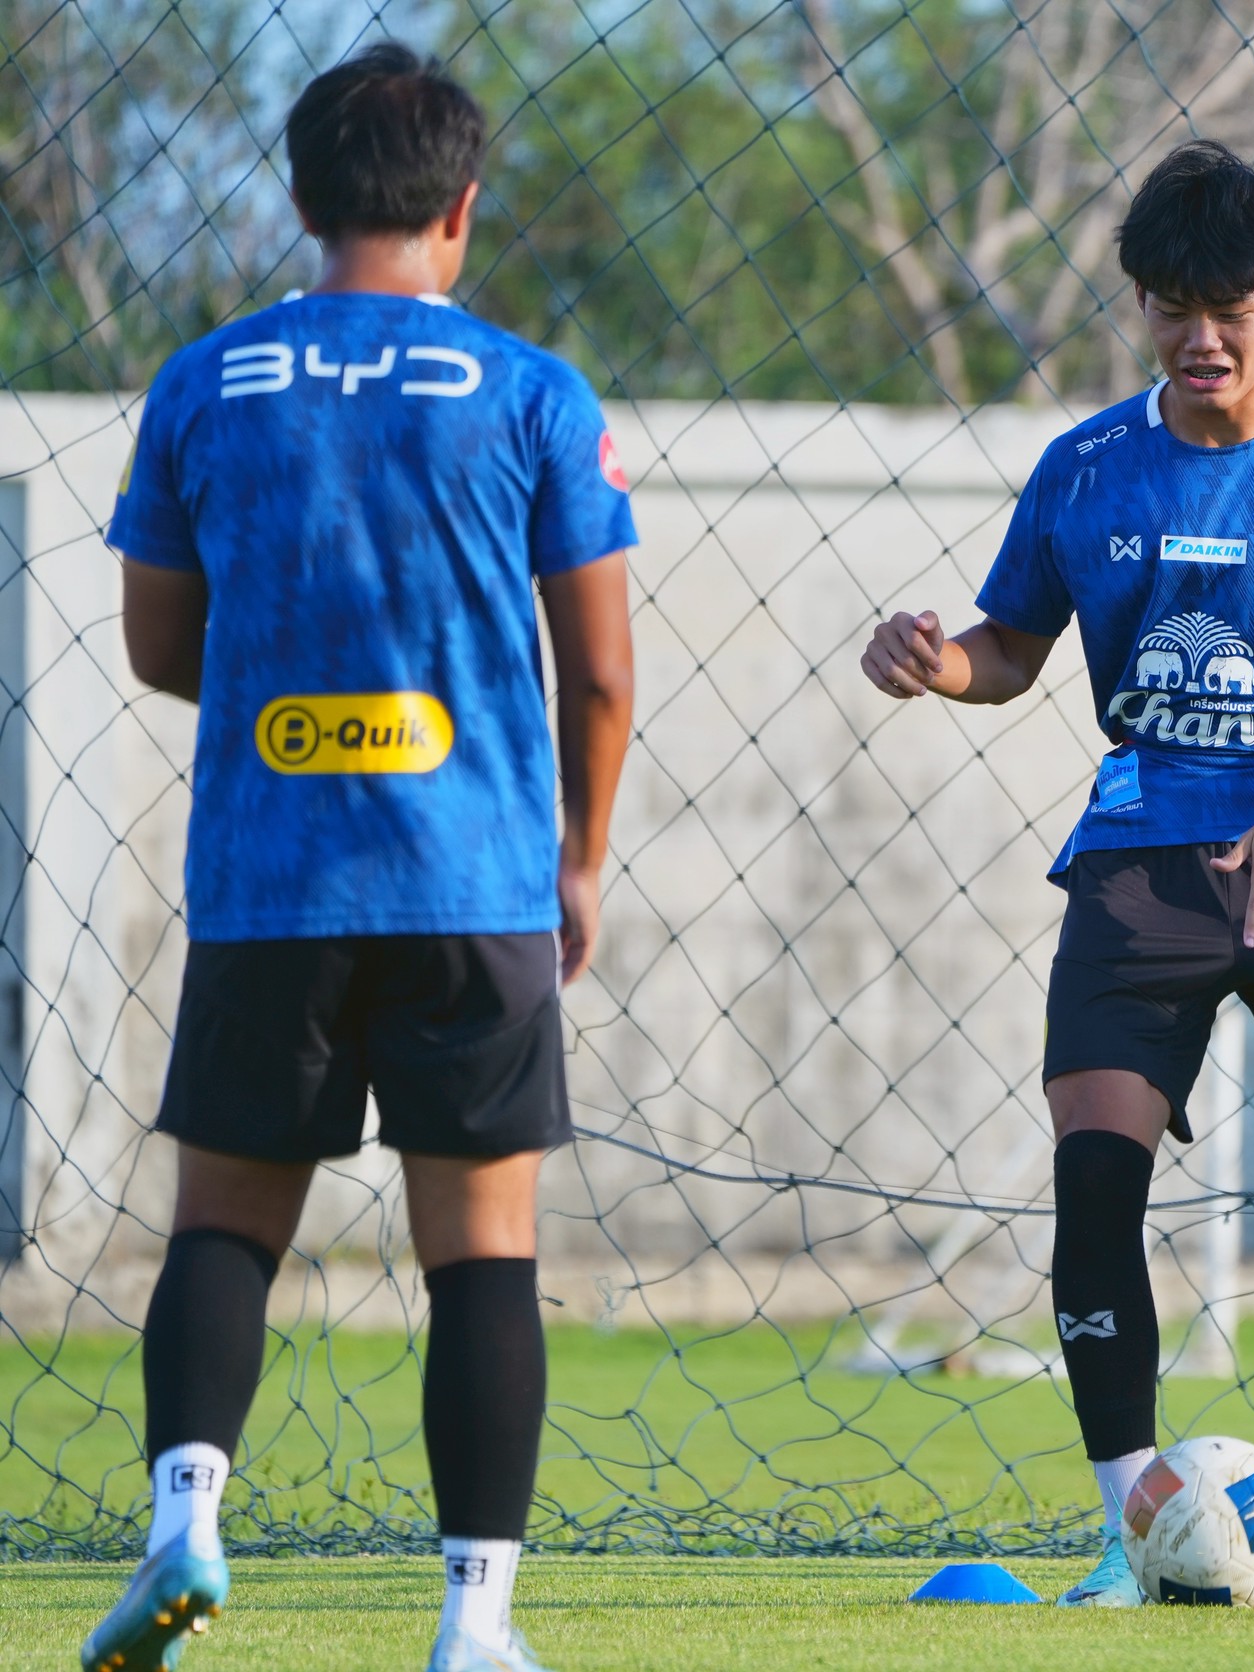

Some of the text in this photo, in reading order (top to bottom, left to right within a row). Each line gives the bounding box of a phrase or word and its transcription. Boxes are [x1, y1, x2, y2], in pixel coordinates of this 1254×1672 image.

[221, 342, 483, 398] BYD
[1076, 425, 1128, 455] BYD
[1179, 542, 1244, 560] DAIKIN
[270, 708, 428, 763] B-Quik
